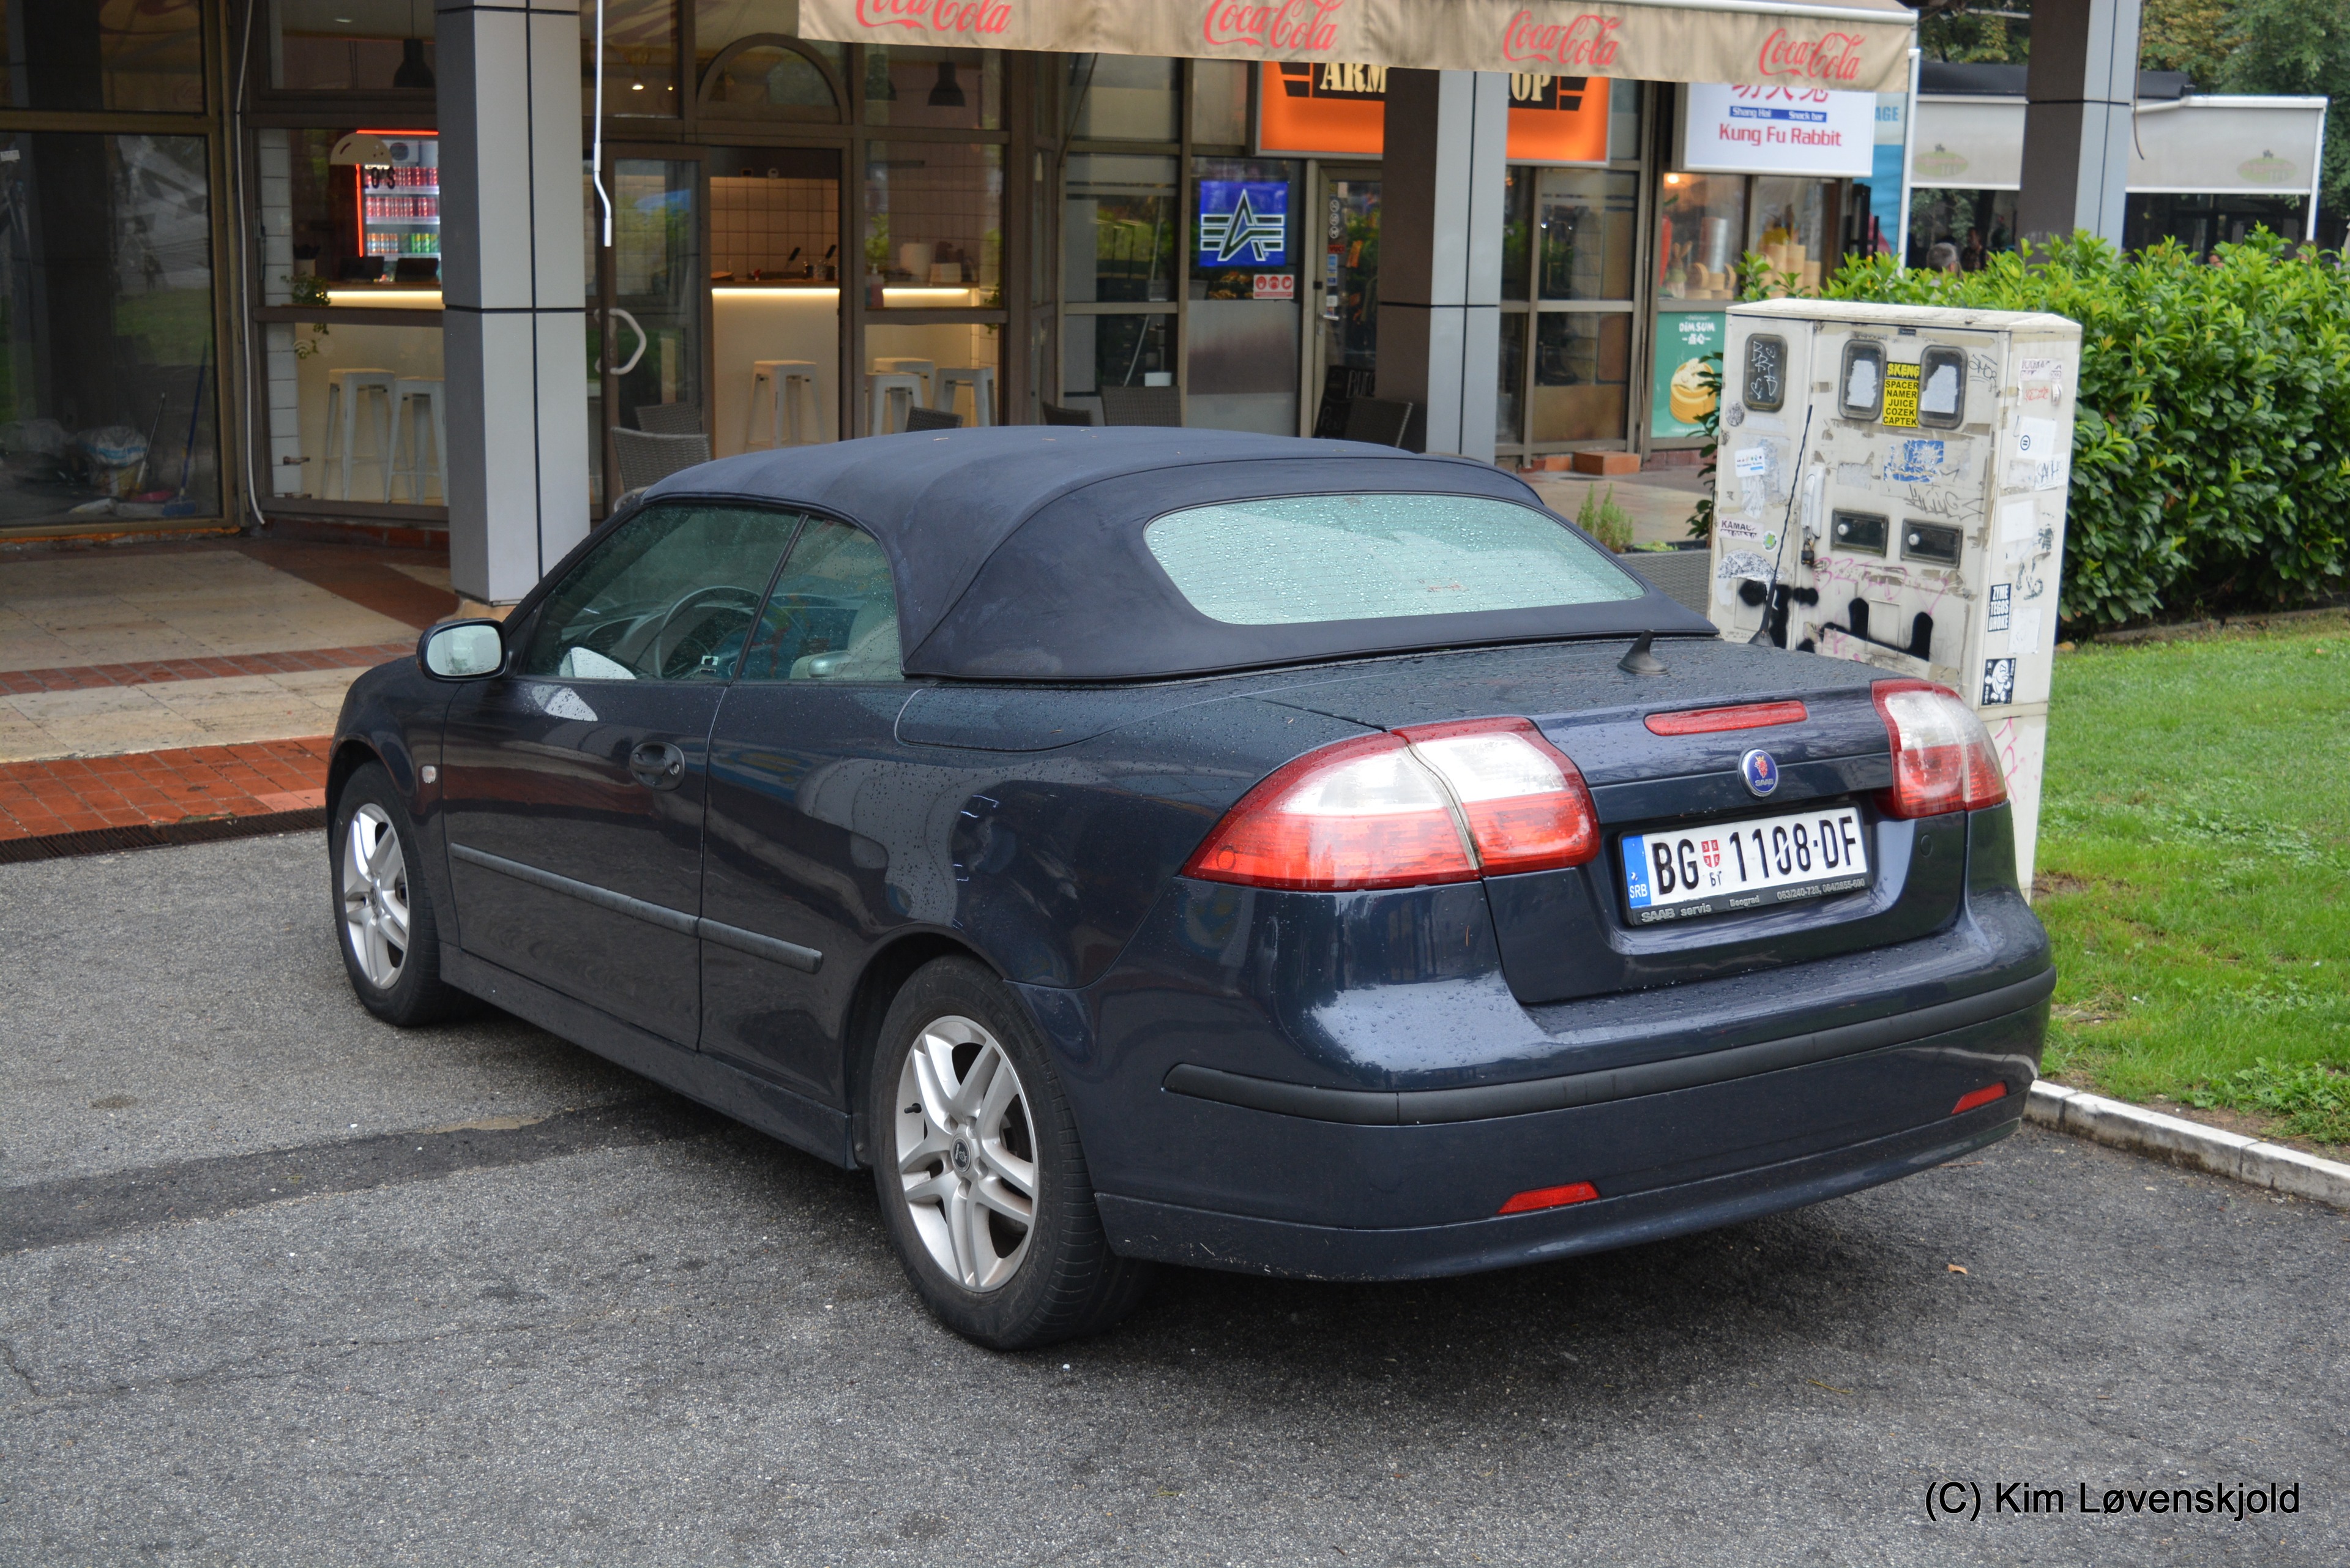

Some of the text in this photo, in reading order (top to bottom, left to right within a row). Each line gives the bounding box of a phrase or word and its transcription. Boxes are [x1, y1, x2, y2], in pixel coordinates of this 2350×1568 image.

[1503, 10, 1623, 65] Coca-Cola
[1758, 28, 1866, 81] Coca-Cola
[1719, 123, 1841, 147] Kung Fu Rabbit
[1886, 381, 1919, 389] SPACER
[1886, 390, 1917, 398] NAMER
[1888, 399, 1914, 408] JUICE
[1886, 408, 1915, 417] COZEK
[1883, 417, 1917, 426] CAPTEK
[1992, 585, 2009, 600] ZYME
[1990, 600, 2009, 616] TEGOS
[1651, 838, 1699, 895] BG
[1629, 884, 1648, 898] SRB
[1641, 908, 1676, 923] SAAB
[1680, 903, 1712, 917] servis
[1729, 895, 1760, 908] Beograd
